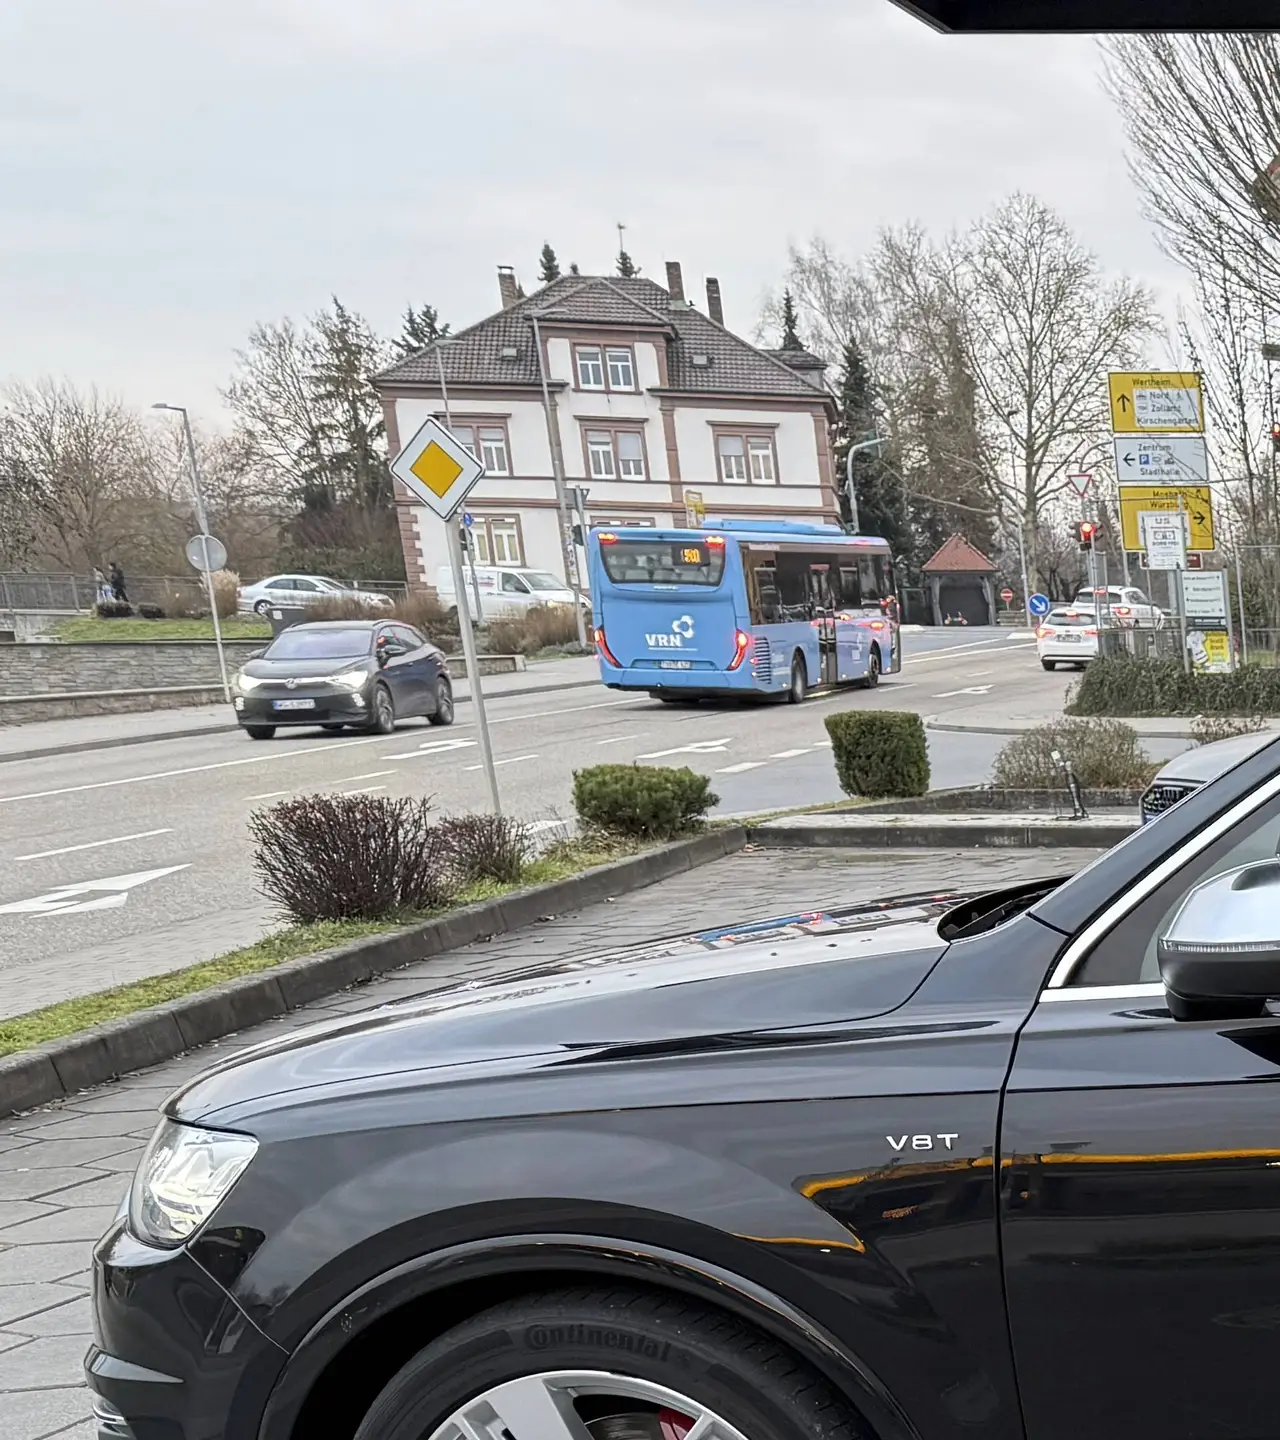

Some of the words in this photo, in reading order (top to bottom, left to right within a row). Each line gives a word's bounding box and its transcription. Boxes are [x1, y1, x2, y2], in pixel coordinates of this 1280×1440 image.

[1132, 378, 1171, 387] Wertheim
[1150, 392, 1169, 400] Nord
[1137, 443, 1172, 452] Zentrum
[1140, 467, 1181, 476] Stadthalle
[645, 633, 683, 647] VRN
[885, 1133, 959, 1151] V8T
[524, 1323, 672, 1363] Continental
